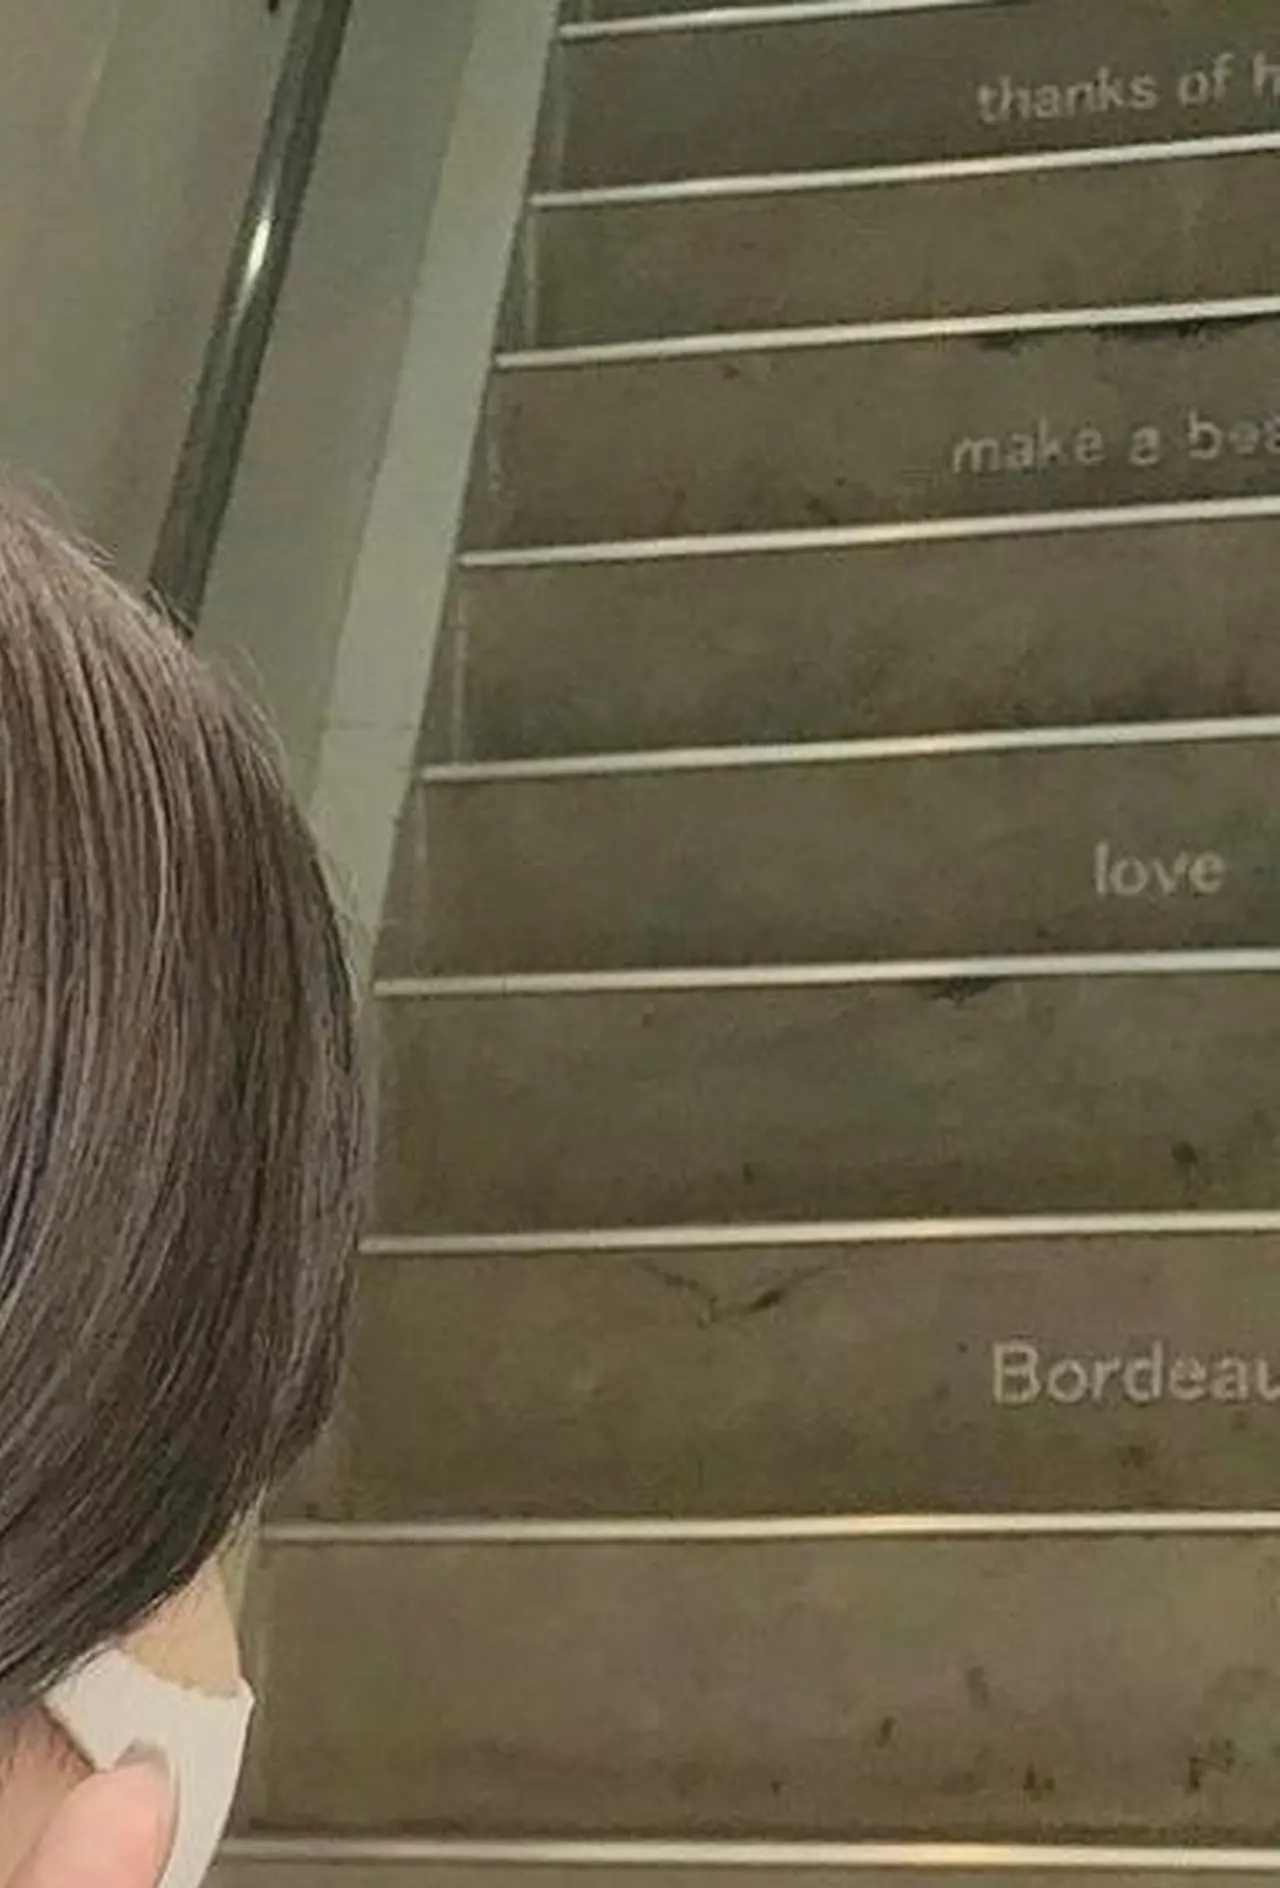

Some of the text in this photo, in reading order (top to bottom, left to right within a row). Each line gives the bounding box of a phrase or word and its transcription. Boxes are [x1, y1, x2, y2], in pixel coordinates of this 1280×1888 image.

[977, 66, 1159, 122] thanks
[1176, 52, 1234, 106] of
[953, 414, 1105, 474] make
[1130, 426, 1162, 466] a
[1095, 842, 1226, 898] love
[993, 1340, 1280, 1404] Bordeau
